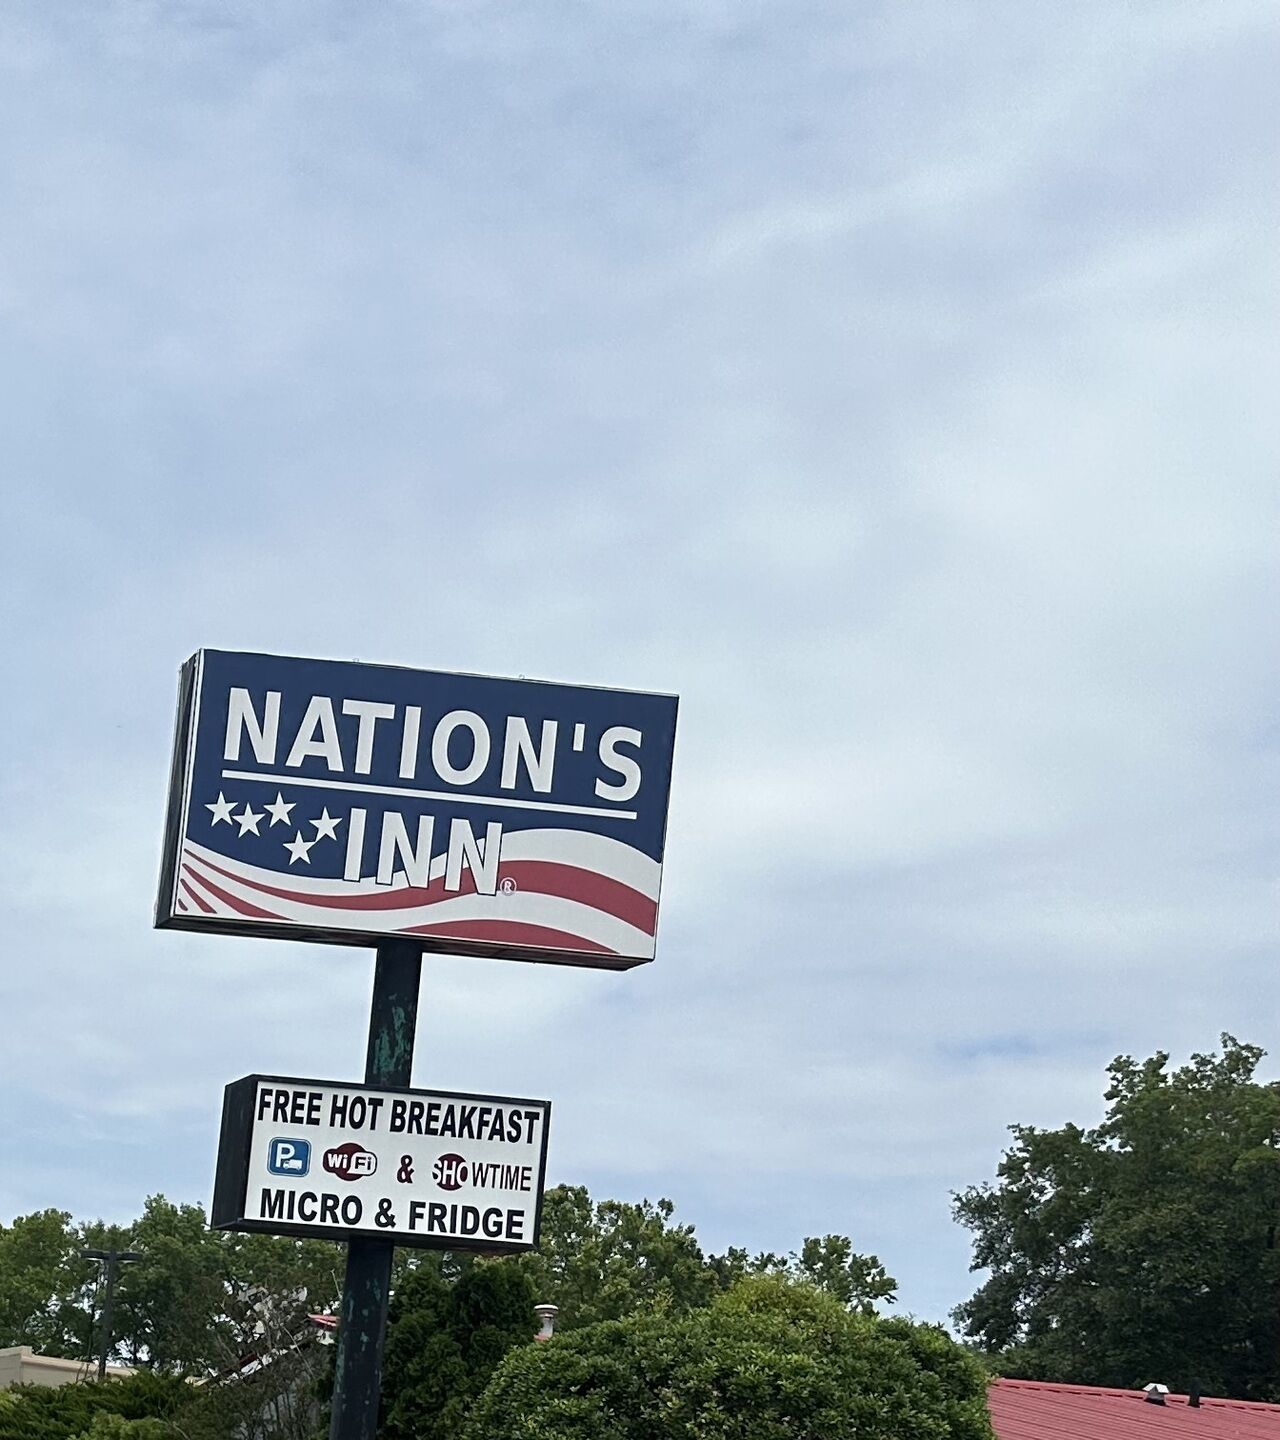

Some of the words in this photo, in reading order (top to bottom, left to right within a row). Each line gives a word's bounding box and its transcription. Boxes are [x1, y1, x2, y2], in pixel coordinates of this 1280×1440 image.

[223, 687, 643, 802] NATION'S
[342, 808, 503, 896] INN
[257, 1088, 323, 1127] FREE
[329, 1094, 383, 1131] HOT
[389, 1099, 541, 1145] BREAKFAST
[396, 1154, 415, 1184] &
[432, 1153, 533, 1192] SHOWTIME
[259, 1188, 363, 1226] MICRO
[374, 1197, 397, 1229] &
[408, 1201, 525, 1240] FRIDGE
